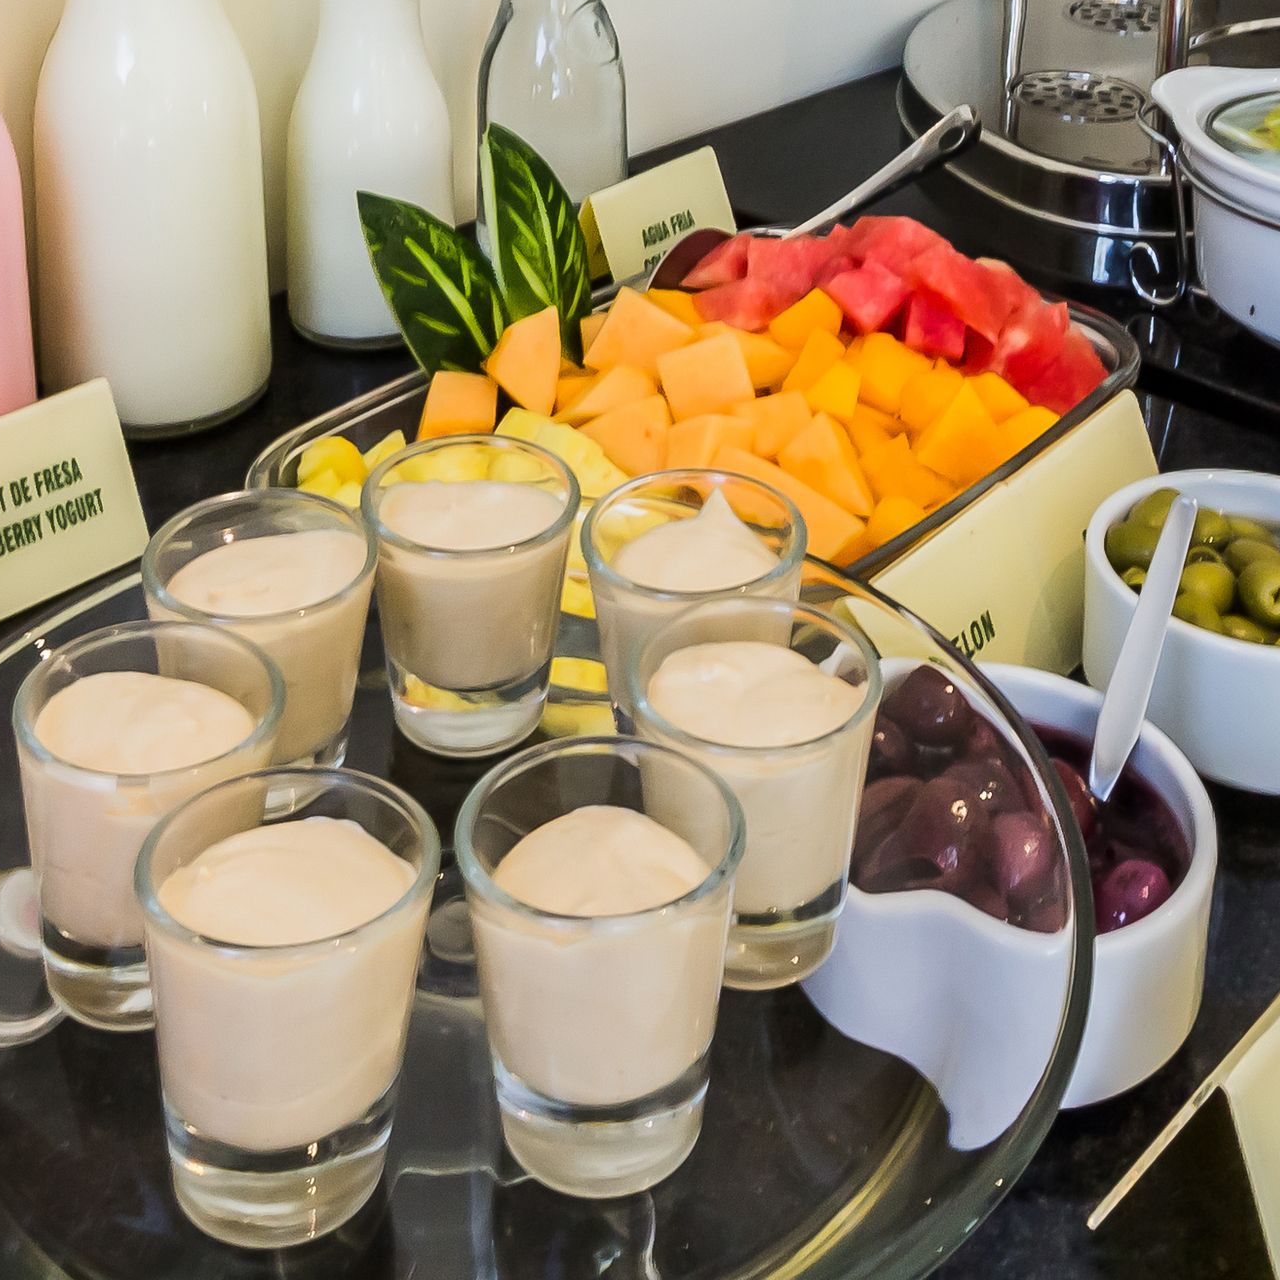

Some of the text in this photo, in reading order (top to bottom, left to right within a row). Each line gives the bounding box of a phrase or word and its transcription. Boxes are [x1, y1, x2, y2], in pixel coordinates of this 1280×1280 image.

[642, 209, 696, 248] AGUA FRIA
[10, 478, 32, 506] DE
[33, 457, 83, 497] FRESA
[45, 488, 105, 535] YOGURT
